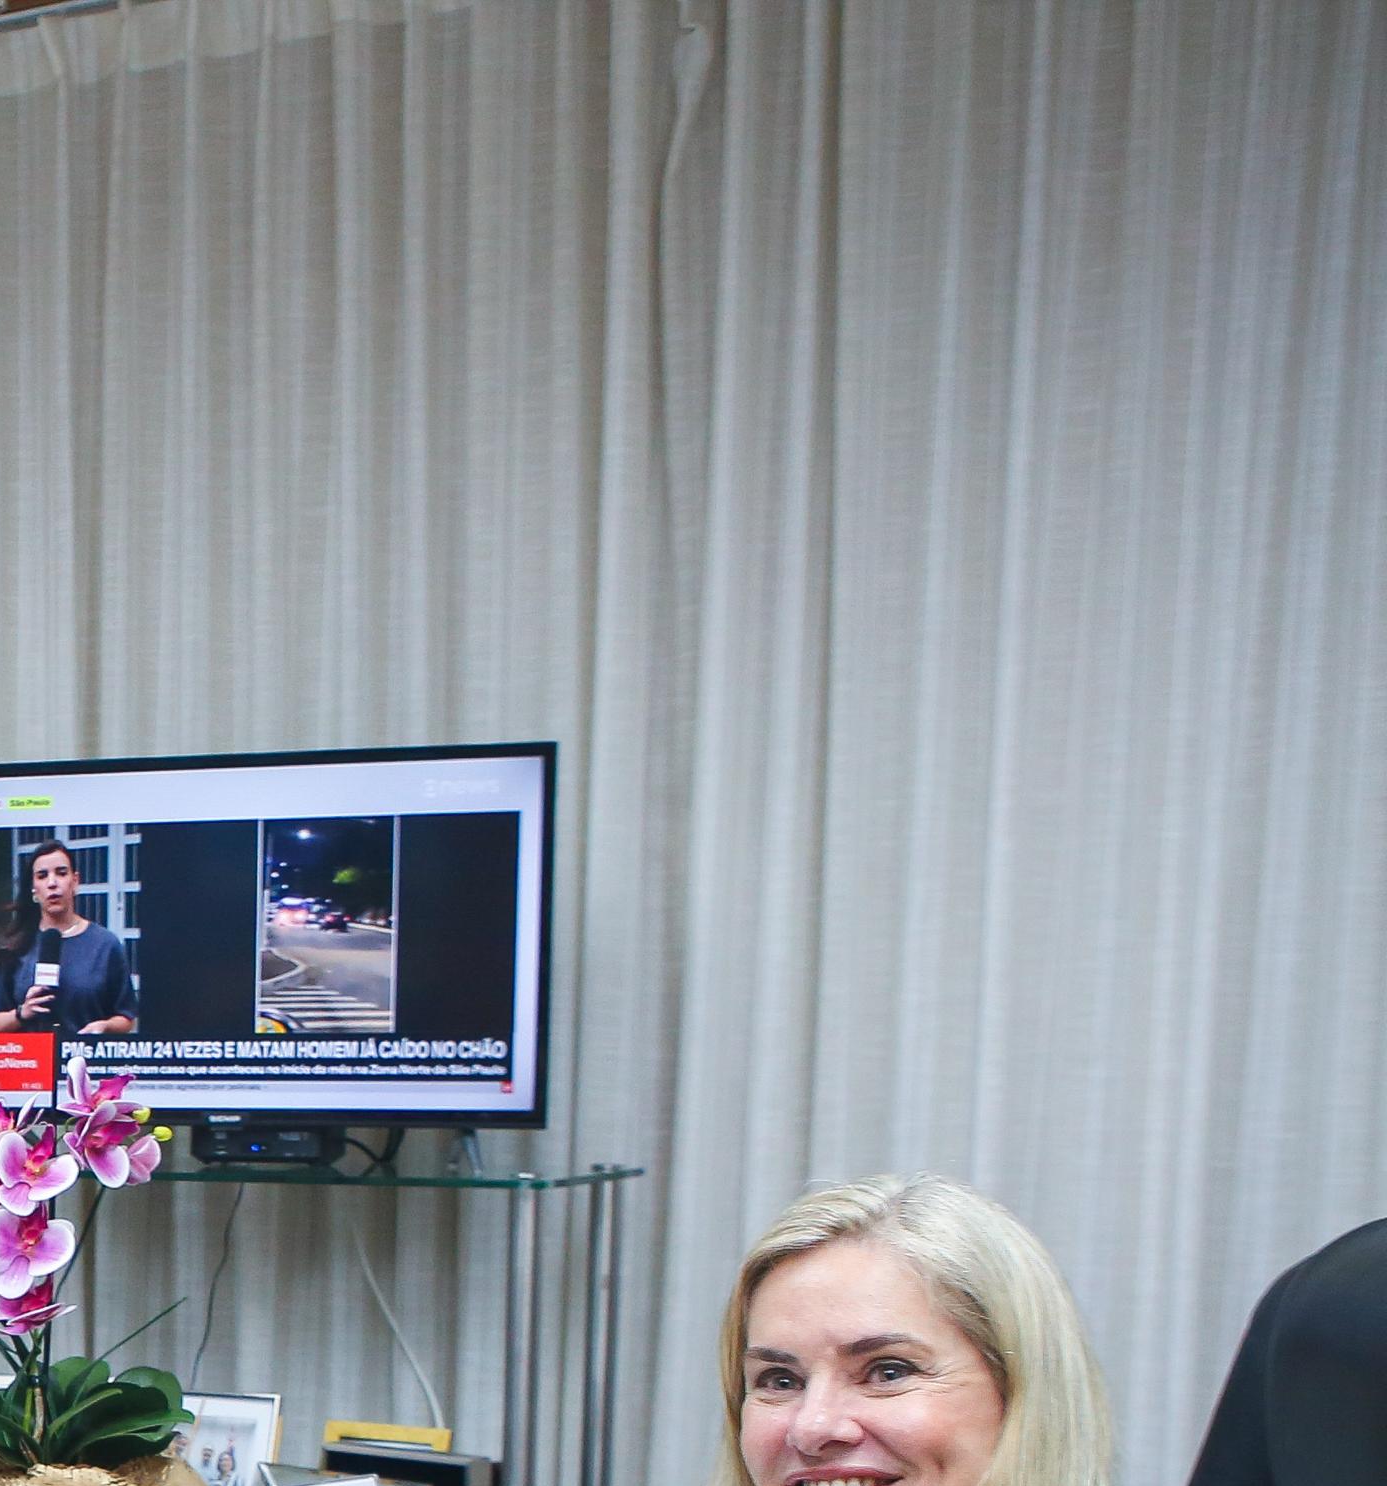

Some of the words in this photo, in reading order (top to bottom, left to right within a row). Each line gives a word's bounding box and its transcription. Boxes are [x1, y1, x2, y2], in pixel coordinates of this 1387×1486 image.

[60, 1041, 94, 1059] PMs
[94, 1041, 152, 1059] ATIRAM
[153, 1041, 173, 1059] 24
[174, 1041, 223, 1059] VEZES
[224, 1041, 235, 1058] E
[236, 1040, 296, 1058] MATAM
[297, 1040, 358, 1058] HOMEM
[359, 1037, 377, 1058] JÁ
[378, 1037, 430, 1058] CAÍDO
[431, 1040, 457, 1058] NO
[458, 1037, 508, 1058] CHÃO
[107, 1065, 158, 1076] registram
[186, 1067, 207, 1076] que
